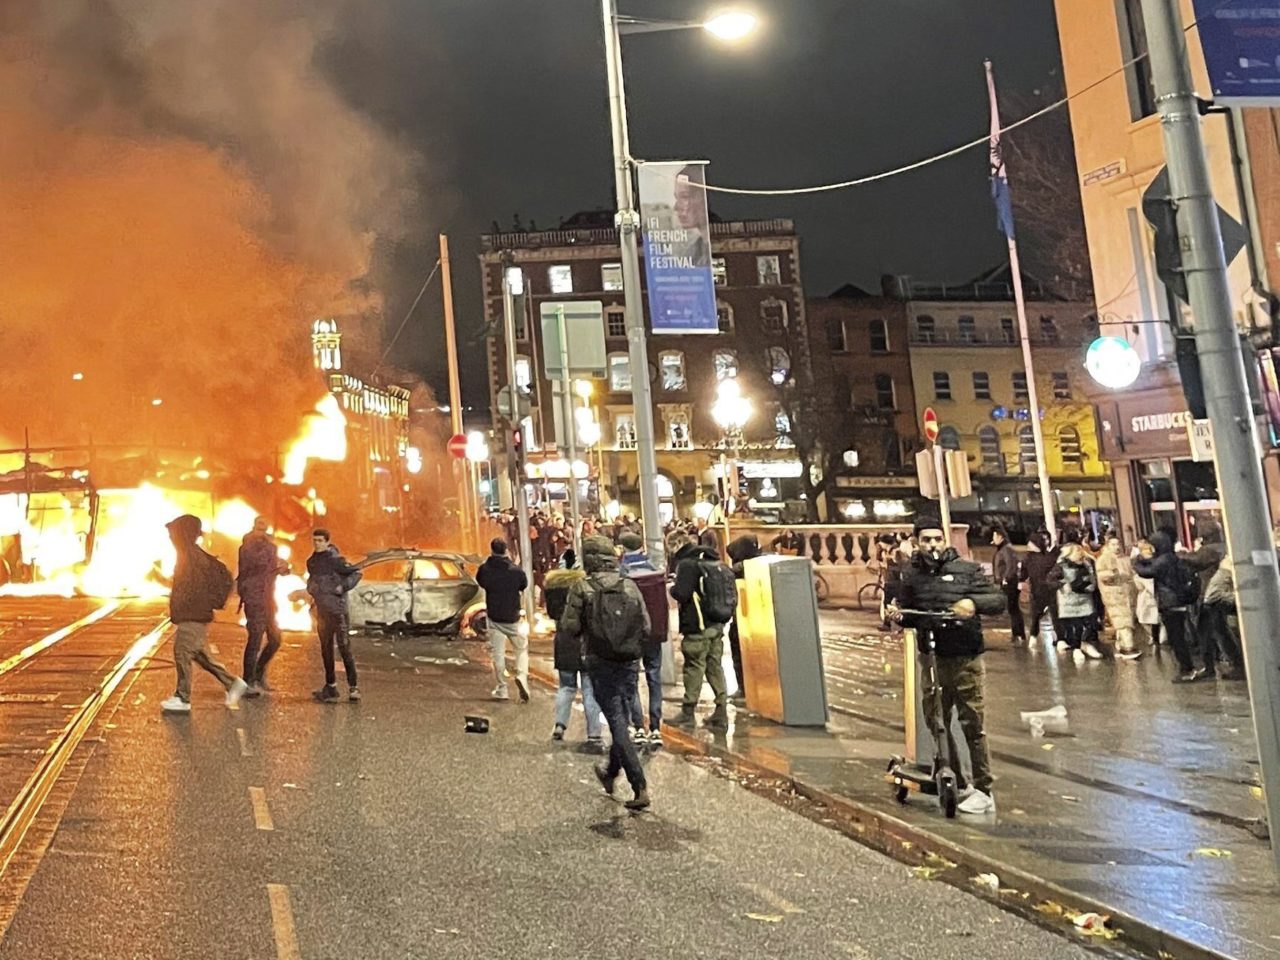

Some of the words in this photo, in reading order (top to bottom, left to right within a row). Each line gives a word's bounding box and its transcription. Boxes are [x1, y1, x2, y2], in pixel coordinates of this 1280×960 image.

[647, 217, 660, 229] IFI
[648, 230, 688, 242] FRENCH
[649, 243, 673, 255] FILM
[650, 256, 695, 269] FESTIVAL
[1131, 410, 1193, 433] STARBUCKS
